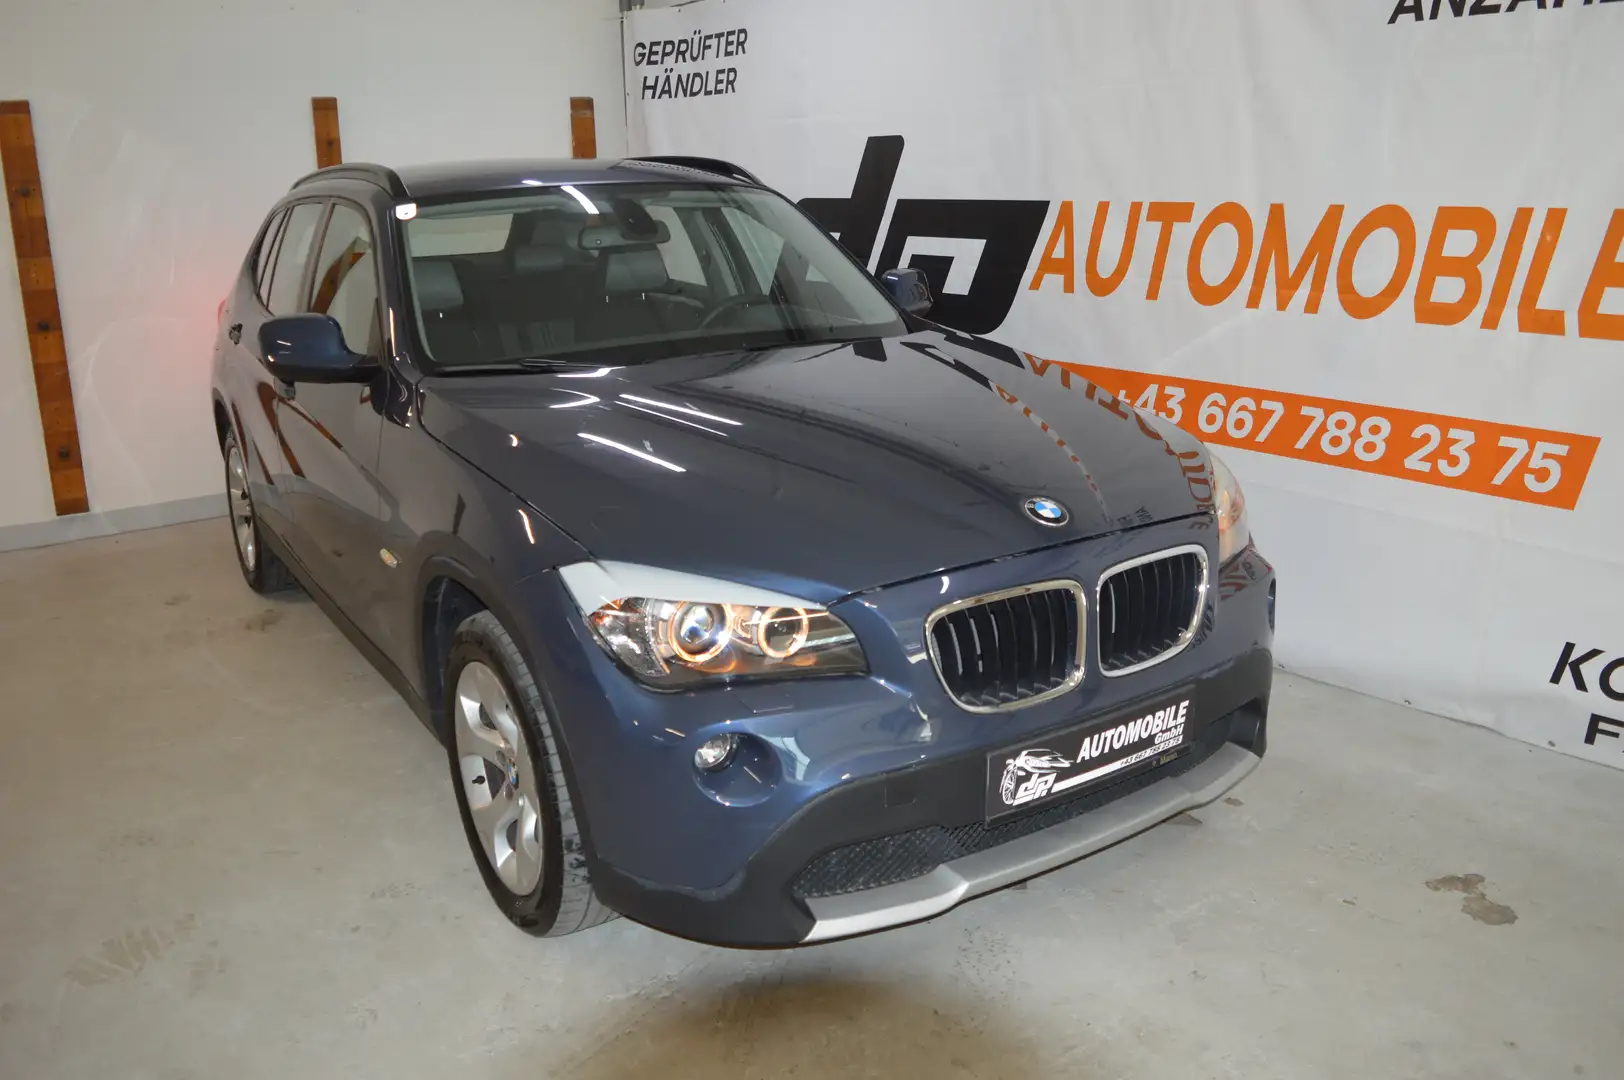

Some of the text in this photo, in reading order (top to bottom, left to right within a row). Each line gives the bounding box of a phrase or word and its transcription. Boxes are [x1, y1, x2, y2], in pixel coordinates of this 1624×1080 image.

[633, 28, 748, 66] GEPRÜFTER
[641, 67, 738, 100] HÄNDLER
[1197, 392, 1285, 443] 667
[1294, 405, 1391, 462] 788
[1403, 423, 1476, 477] 23
[1490, 435, 1570, 493] 75
[1076, 700, 1190, 763] AUTOMOBILE
[1154, 723, 1184, 744] GmbH
[1584, 712, 1624, 753] F
